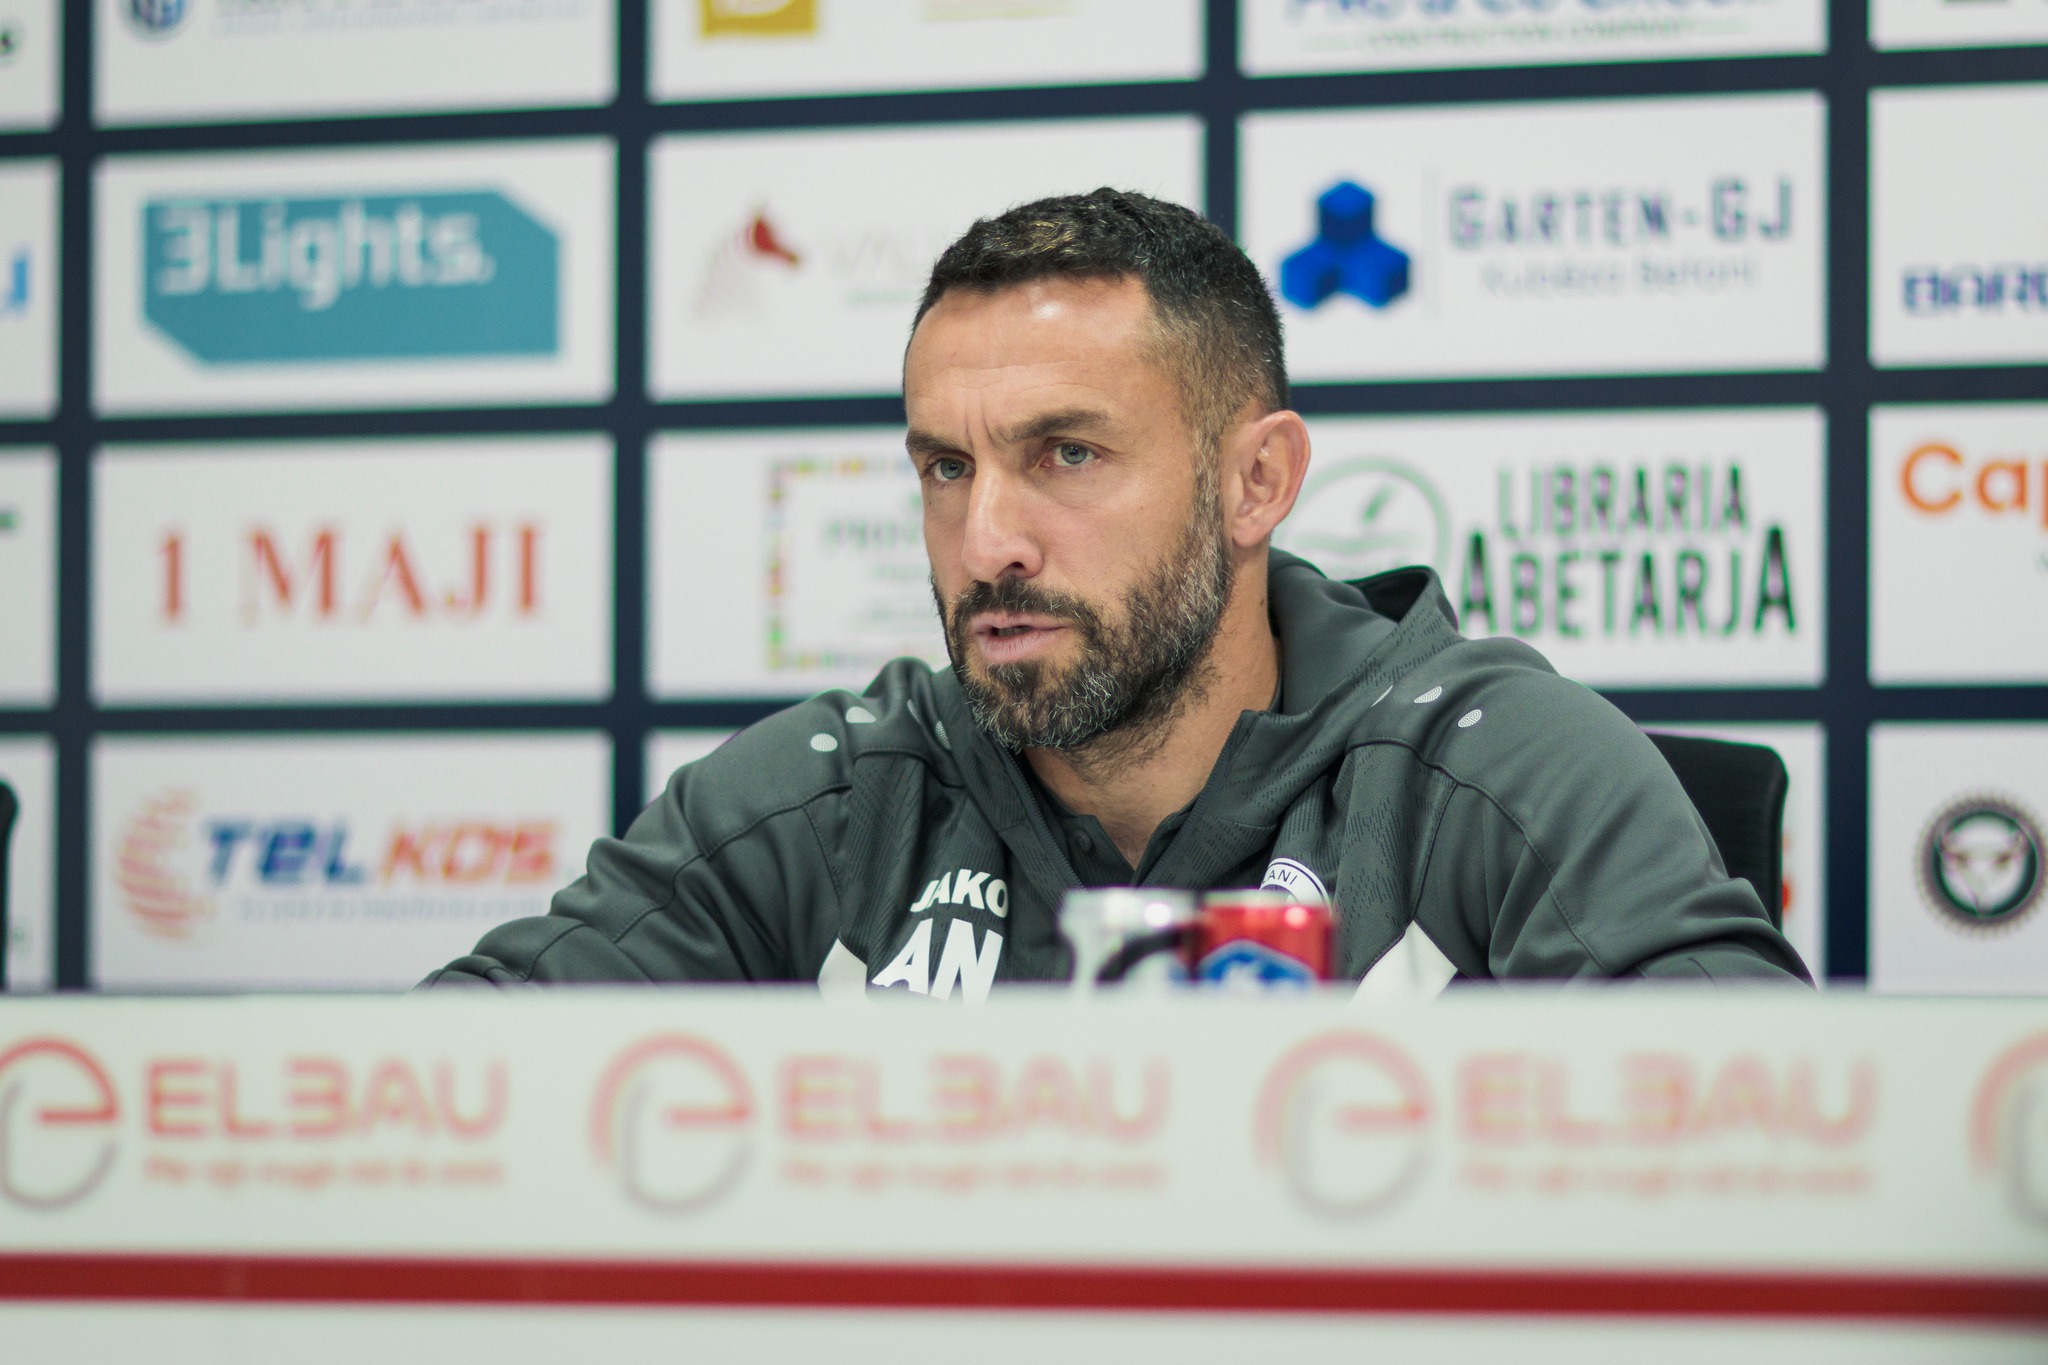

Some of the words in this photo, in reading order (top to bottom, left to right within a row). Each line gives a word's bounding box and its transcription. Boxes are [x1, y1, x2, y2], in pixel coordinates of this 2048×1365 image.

[1450, 176, 1793, 248] GARTEN-GJ
[1498, 465, 1748, 537] LIBRARIA
[1899, 440, 2048, 532] Ca
[159, 530, 186, 622] 1
[240, 524, 543, 624] MAJI
[1458, 527, 1796, 635] ABETARJA
[910, 868, 1009, 918] JAKO
[1261, 868, 1298, 885] ANI
